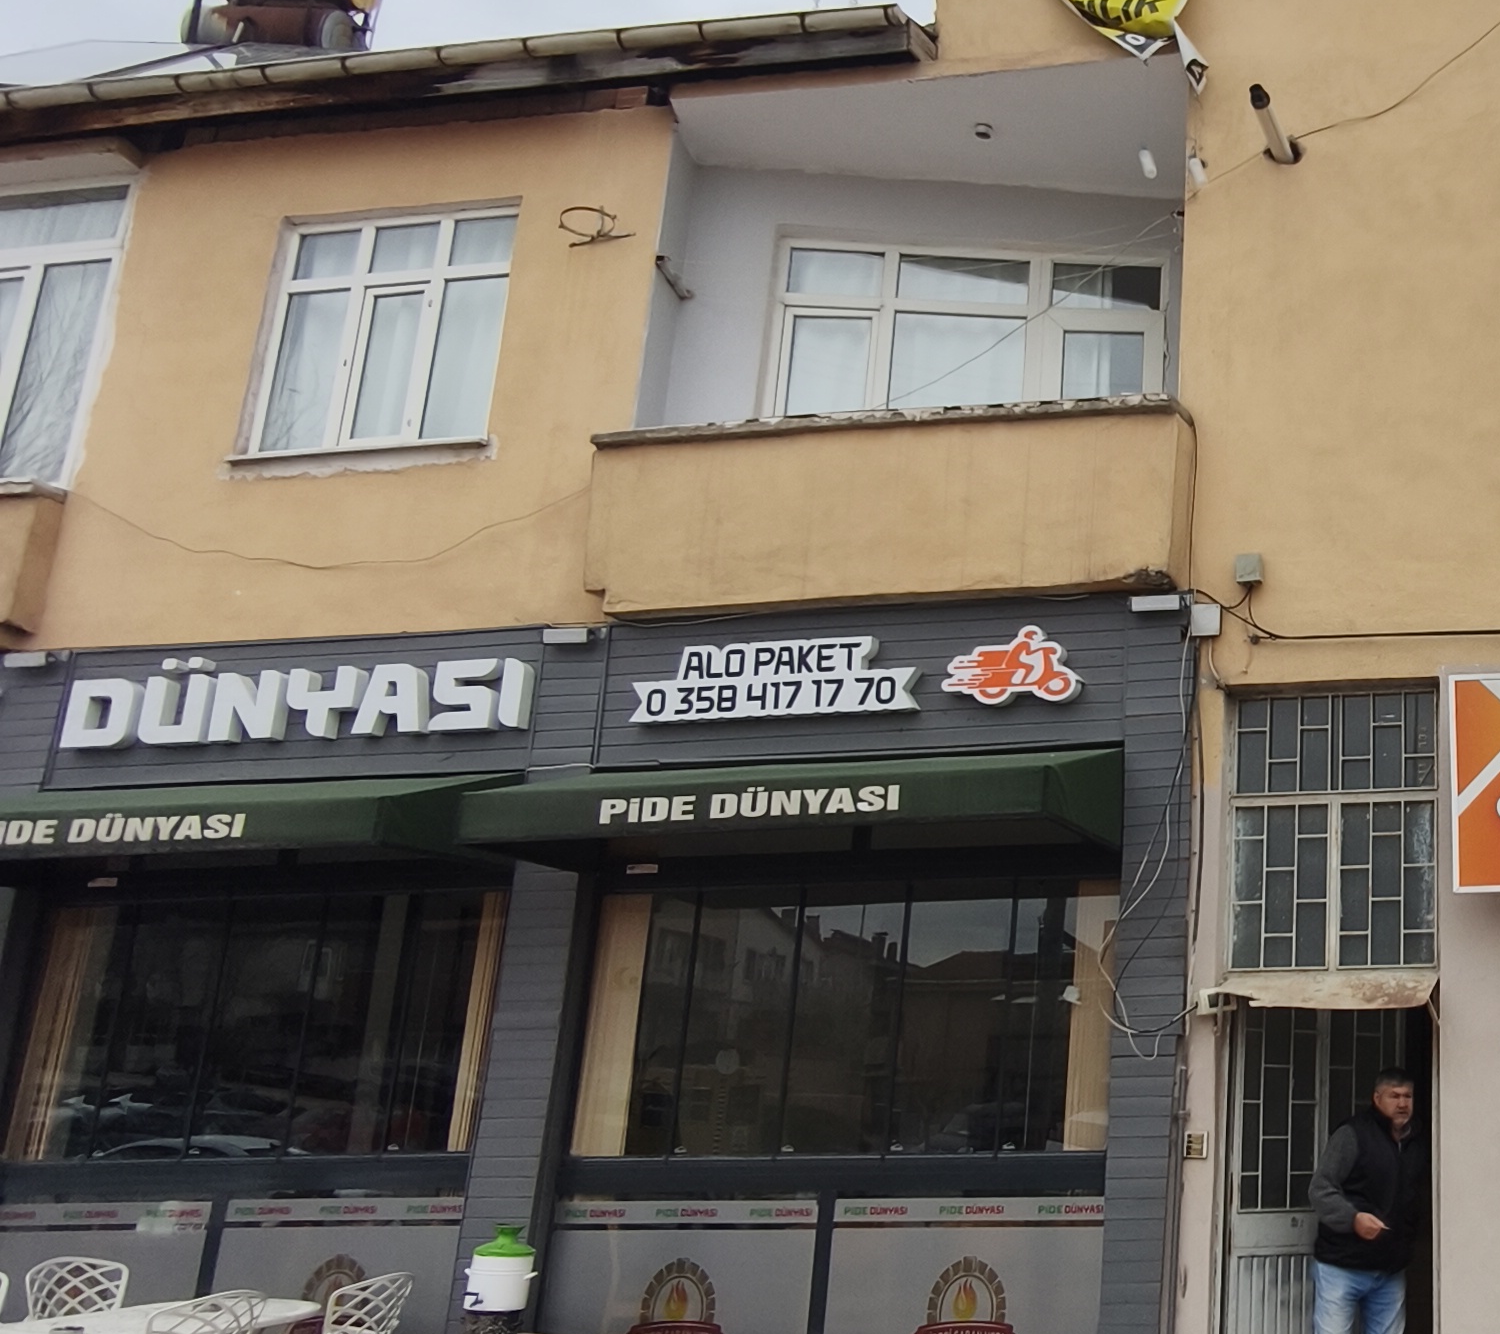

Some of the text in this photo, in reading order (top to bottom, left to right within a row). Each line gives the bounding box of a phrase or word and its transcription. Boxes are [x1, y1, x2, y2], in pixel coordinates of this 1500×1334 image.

[683, 642, 862, 680] ALO PAKET
[59, 655, 535, 749] DÜNYASI
[646, 676, 896, 716] 0 358 417 17 70
[710, 785, 900, 818] DÜNYASI
[67, 813, 246, 843] DÜNYASI
